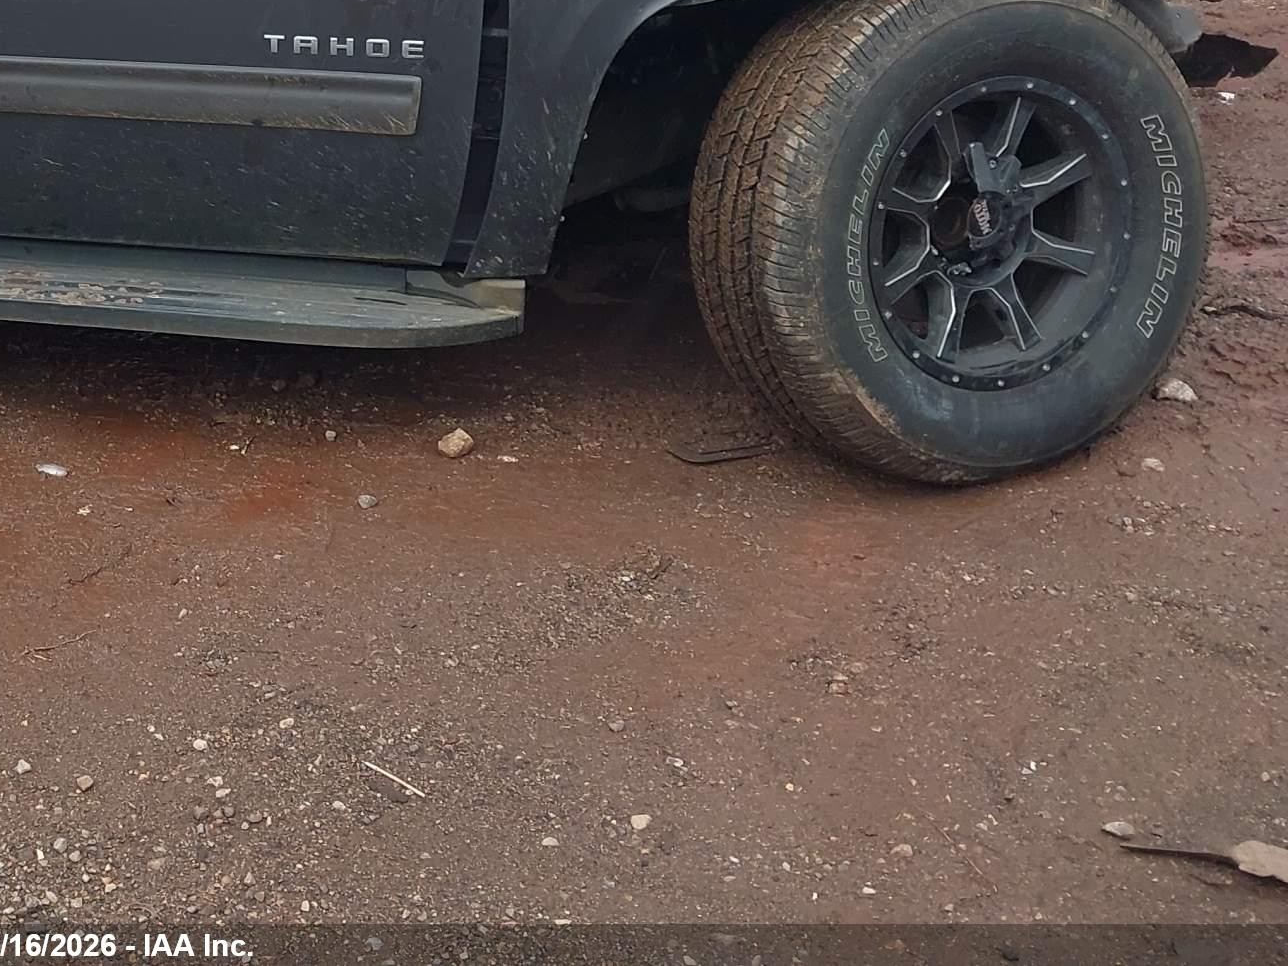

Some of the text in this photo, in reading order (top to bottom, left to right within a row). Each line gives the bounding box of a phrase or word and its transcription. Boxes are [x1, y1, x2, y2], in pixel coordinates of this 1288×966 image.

[263, 34, 425, 59] TAHOE
[846, 128, 891, 363] MICHELIN
[1136, 114, 1183, 339] MICHELIN
